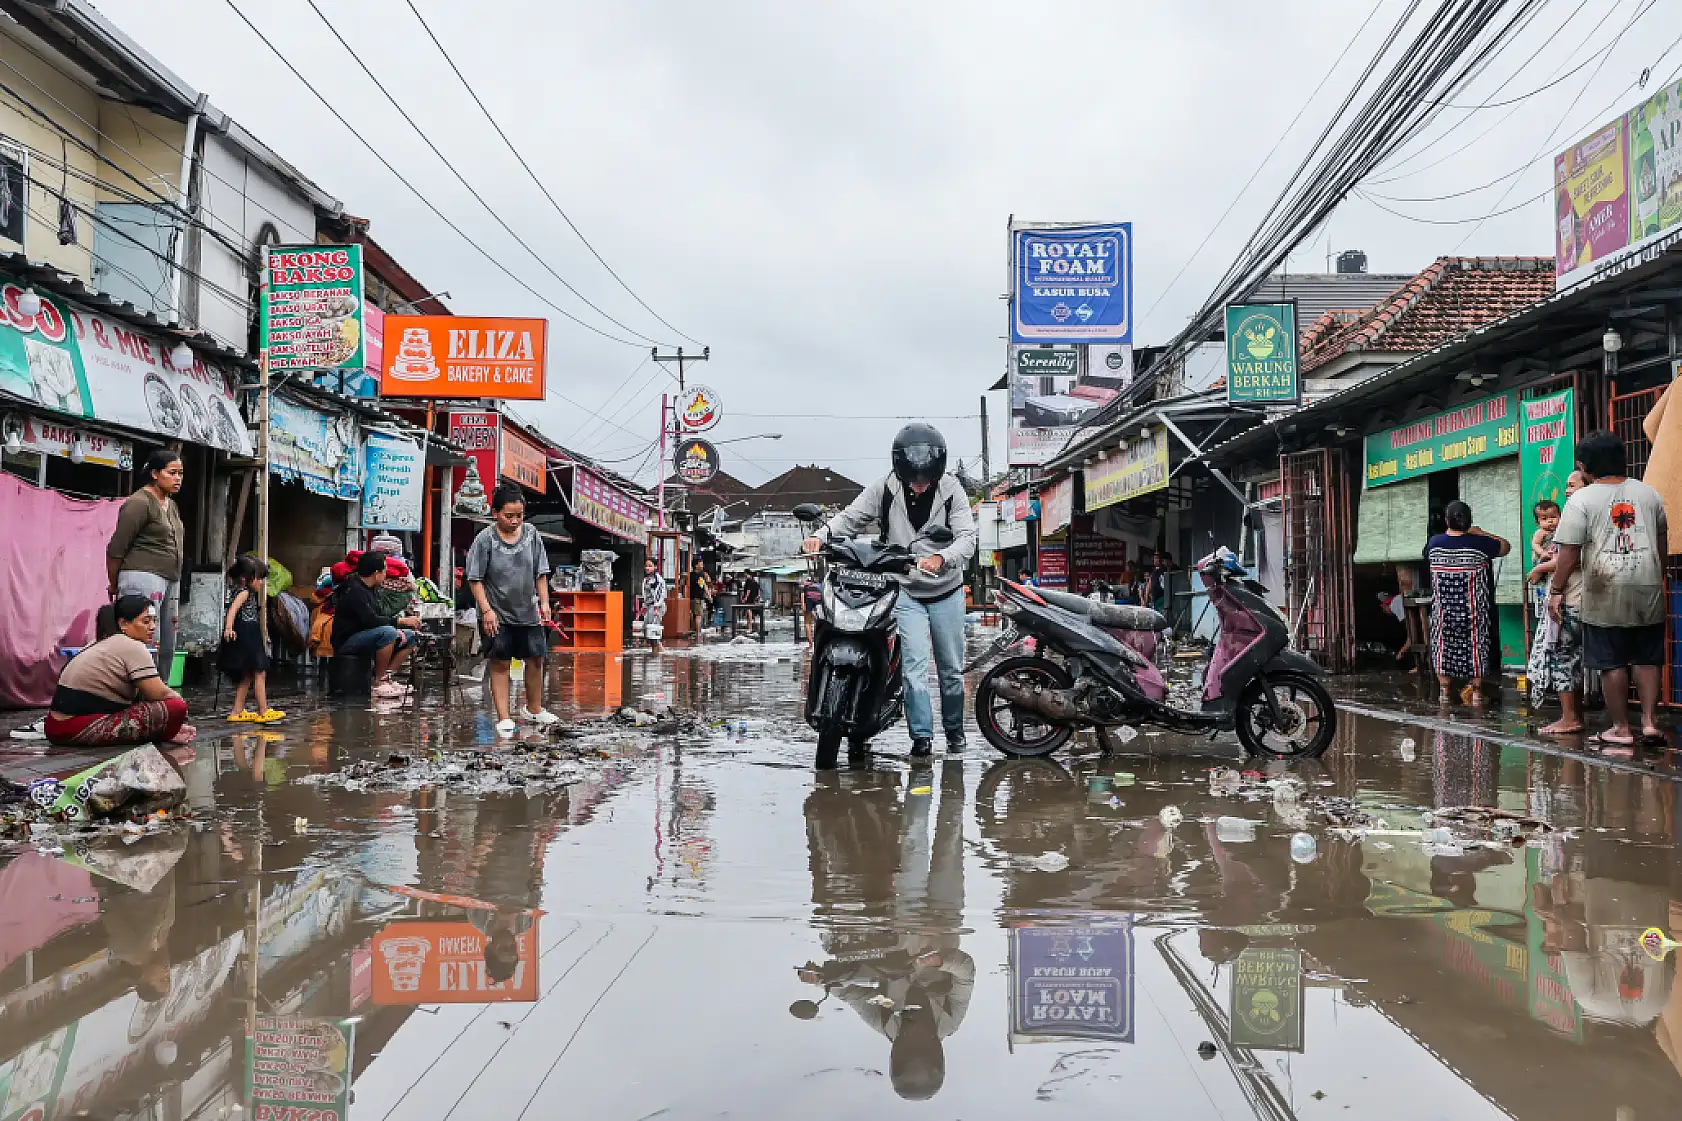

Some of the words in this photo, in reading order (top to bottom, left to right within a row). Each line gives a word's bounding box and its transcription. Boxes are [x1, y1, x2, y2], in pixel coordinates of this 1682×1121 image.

[1032, 243, 1109, 257] ROYAL
[1039, 260, 1105, 274] FOAM
[273, 267, 354, 285] BAKSO
[269, 290, 300, 302] BAKSO
[1033, 288, 1075, 297] KASUR
[1078, 288, 1111, 297] BUSA
[269, 304, 300, 315] BAKSO
[269, 318, 302, 328] BAKSO
[270, 330, 302, 342] BAKSO
[304, 329, 332, 339] AYAM
[114, 326, 156, 366] MIE
[270, 344, 301, 356] BAKSO
[448, 330, 535, 360] ELIZA
[290, 357, 318, 368] AYAM
[1020, 352, 1076, 370] Serenity
[1231, 361, 1292, 374] WARUNG
[448, 366, 490, 382] BAKERY
[493, 367, 502, 383] &
[504, 368, 534, 384] CAKE
[1234, 374, 1291, 388] BERKAH
[1256, 388, 1270, 398] RH
[1526, 396, 1566, 420] WARUNG
[1391, 423, 1432, 449] WARUNG
[1436, 406, 1483, 436] BERKAH
[1486, 395, 1507, 422] RH
[1526, 420, 1566, 444] BERKAH
[1539, 445, 1554, 465] RH
